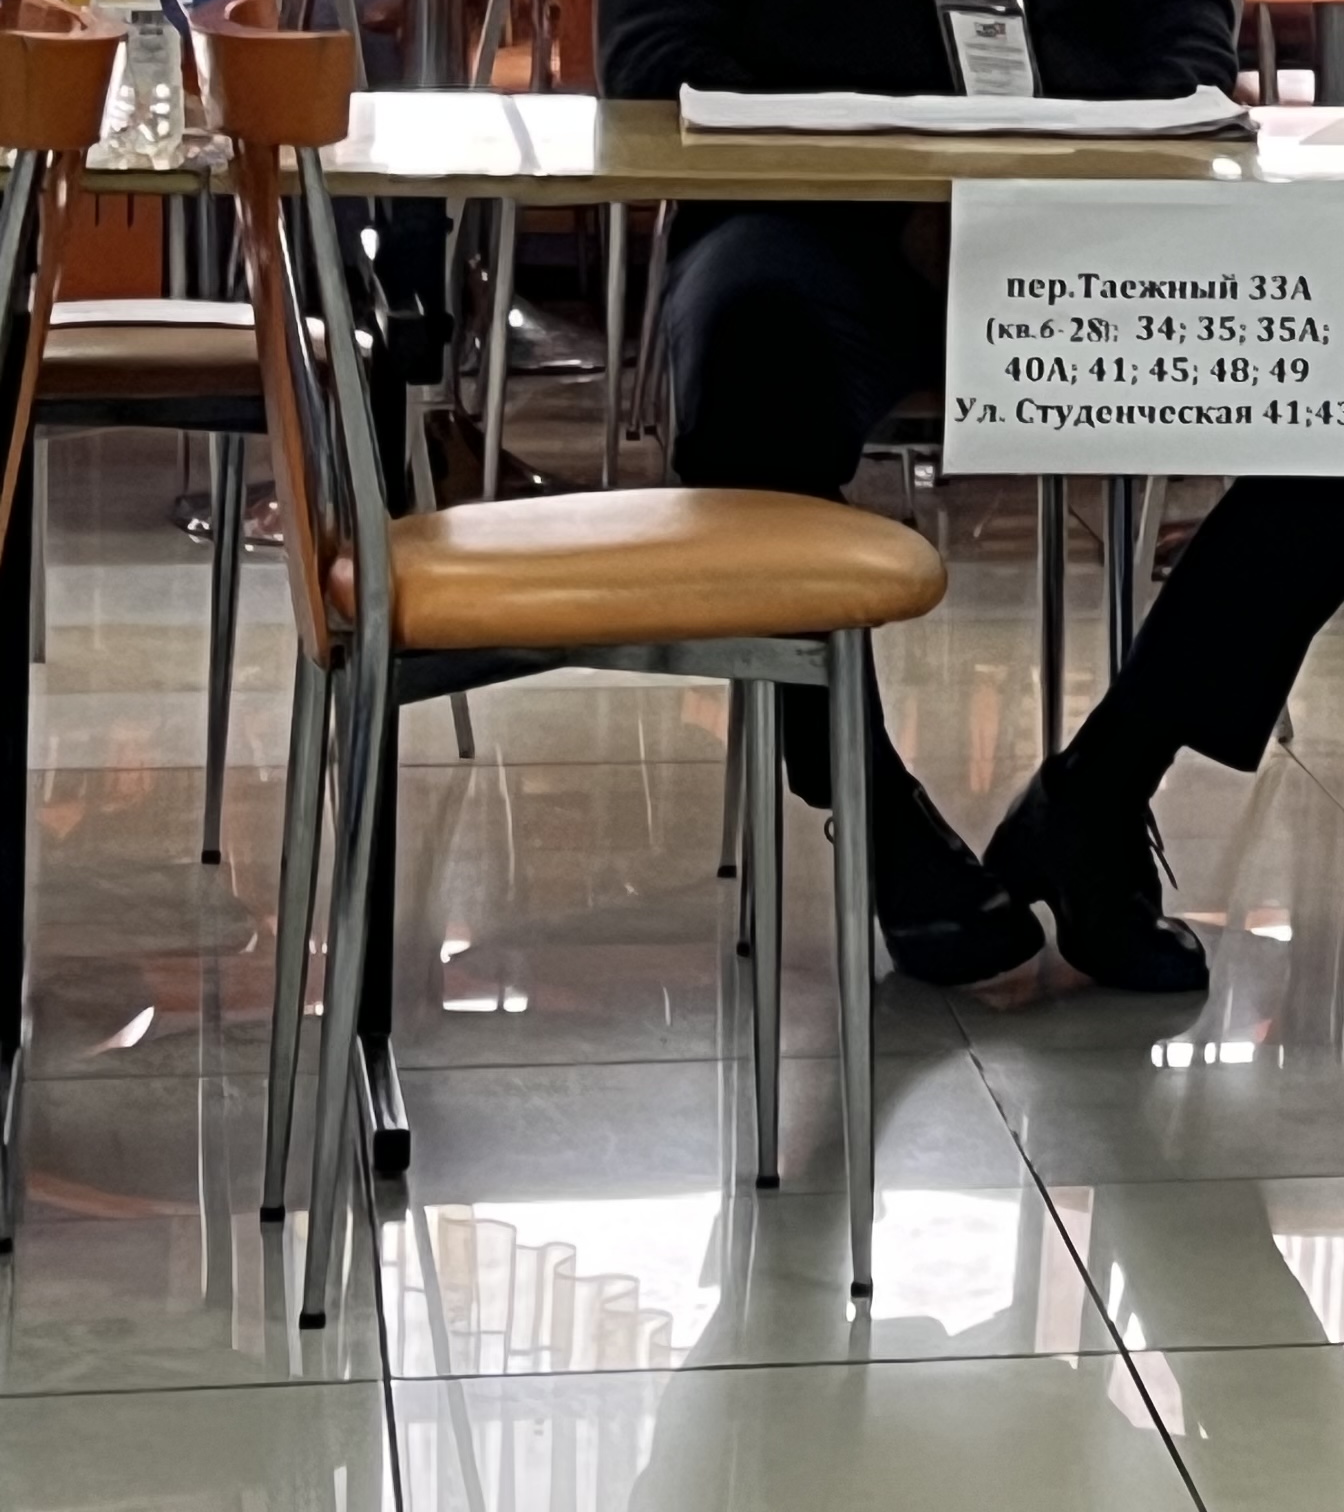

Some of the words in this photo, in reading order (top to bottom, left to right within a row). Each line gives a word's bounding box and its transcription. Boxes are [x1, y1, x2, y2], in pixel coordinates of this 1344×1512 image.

[1248, 274, 1312, 302] 33А
[1135, 315, 1187, 345] 34;
[1196, 315, 1247, 345] 35;
[1256, 316, 1331, 346] 35А;
[1004, 356, 1078, 385] 40А;
[1088, 356, 1139, 386] 41;
[1148, 356, 1199, 386] 45;
[1209, 357, 1259, 387] 48;
[1268, 356, 1311, 384] 49
[953, 396, 1006, 425] Ул.
[1014, 397, 1253, 430] Студенческая
